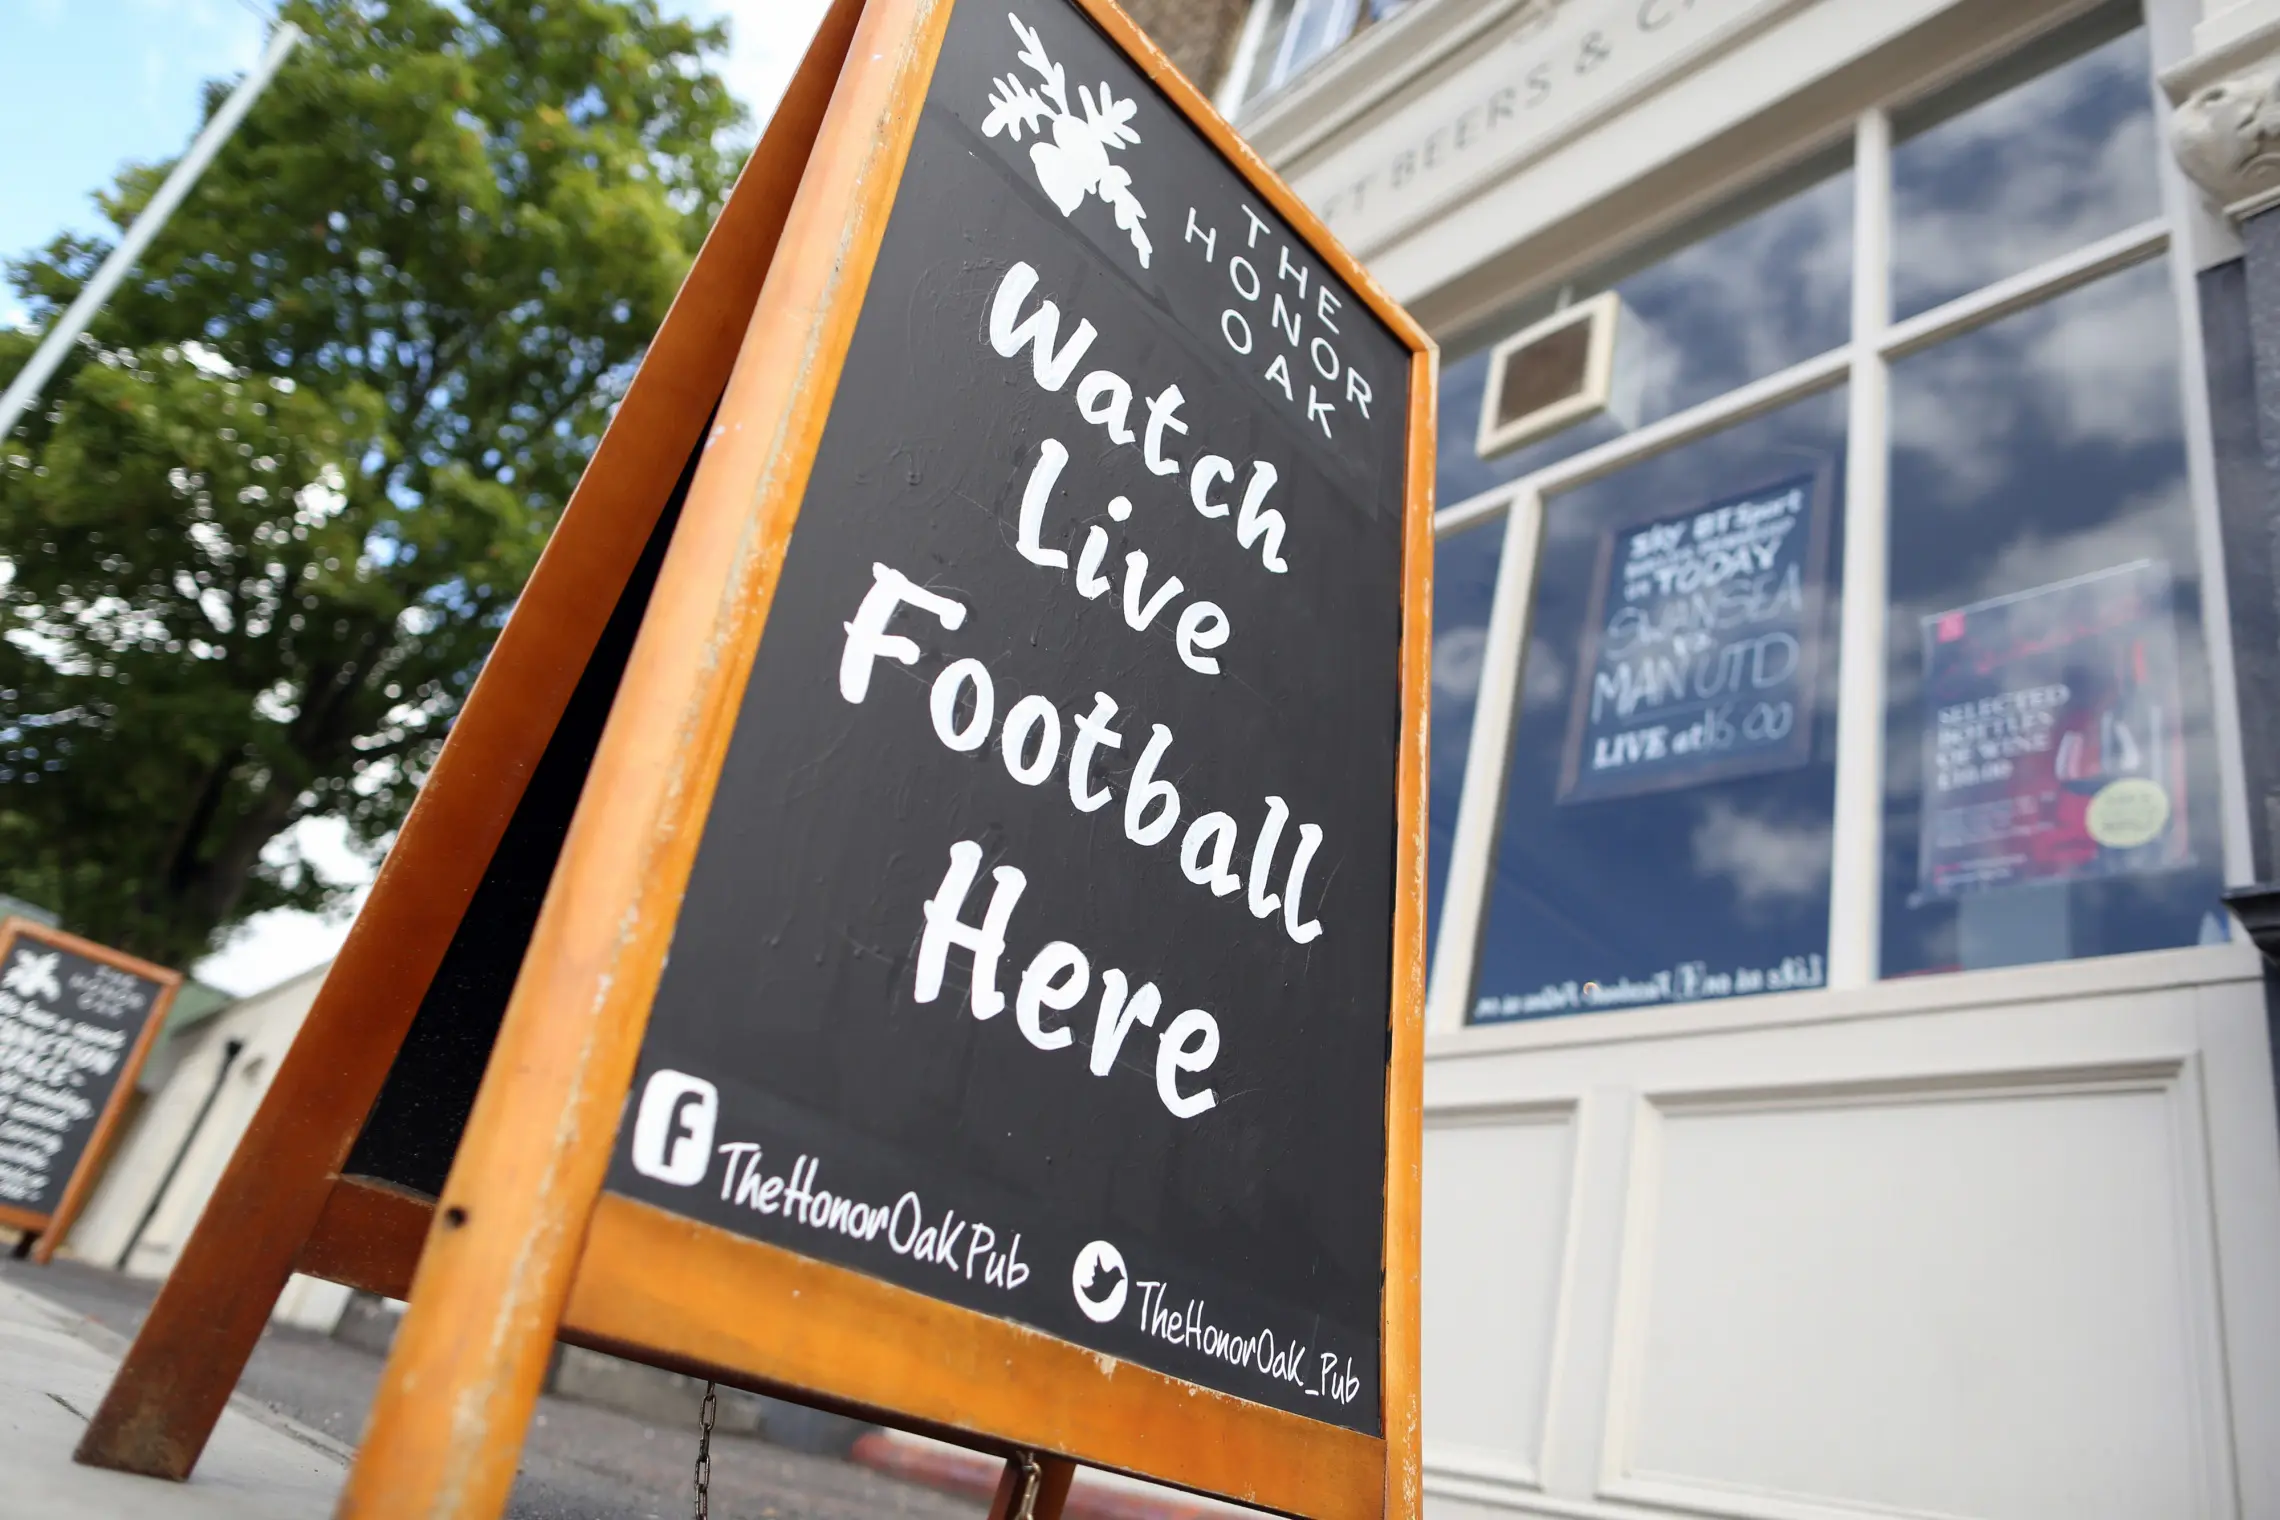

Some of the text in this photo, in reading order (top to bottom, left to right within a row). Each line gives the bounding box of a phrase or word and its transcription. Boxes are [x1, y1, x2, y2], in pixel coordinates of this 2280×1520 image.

[1391, 62, 1552, 190] BEERS
[1574, 31, 1612, 76] &
[1184, 206, 1373, 420] HONOR
[1241, 203, 1342, 335] THE
[989, 260, 1289, 574] Watch
[1220, 308, 1336, 440] OAK
[1016, 438, 1230, 675] Live
[1652, 535, 1783, 595] TODAY
[839, 561, 1324, 944] Football
[1591, 632, 1801, 725] MAN UTD
[1592, 725, 1669, 770] LIVE
[914, 840, 1220, 1118] Here
